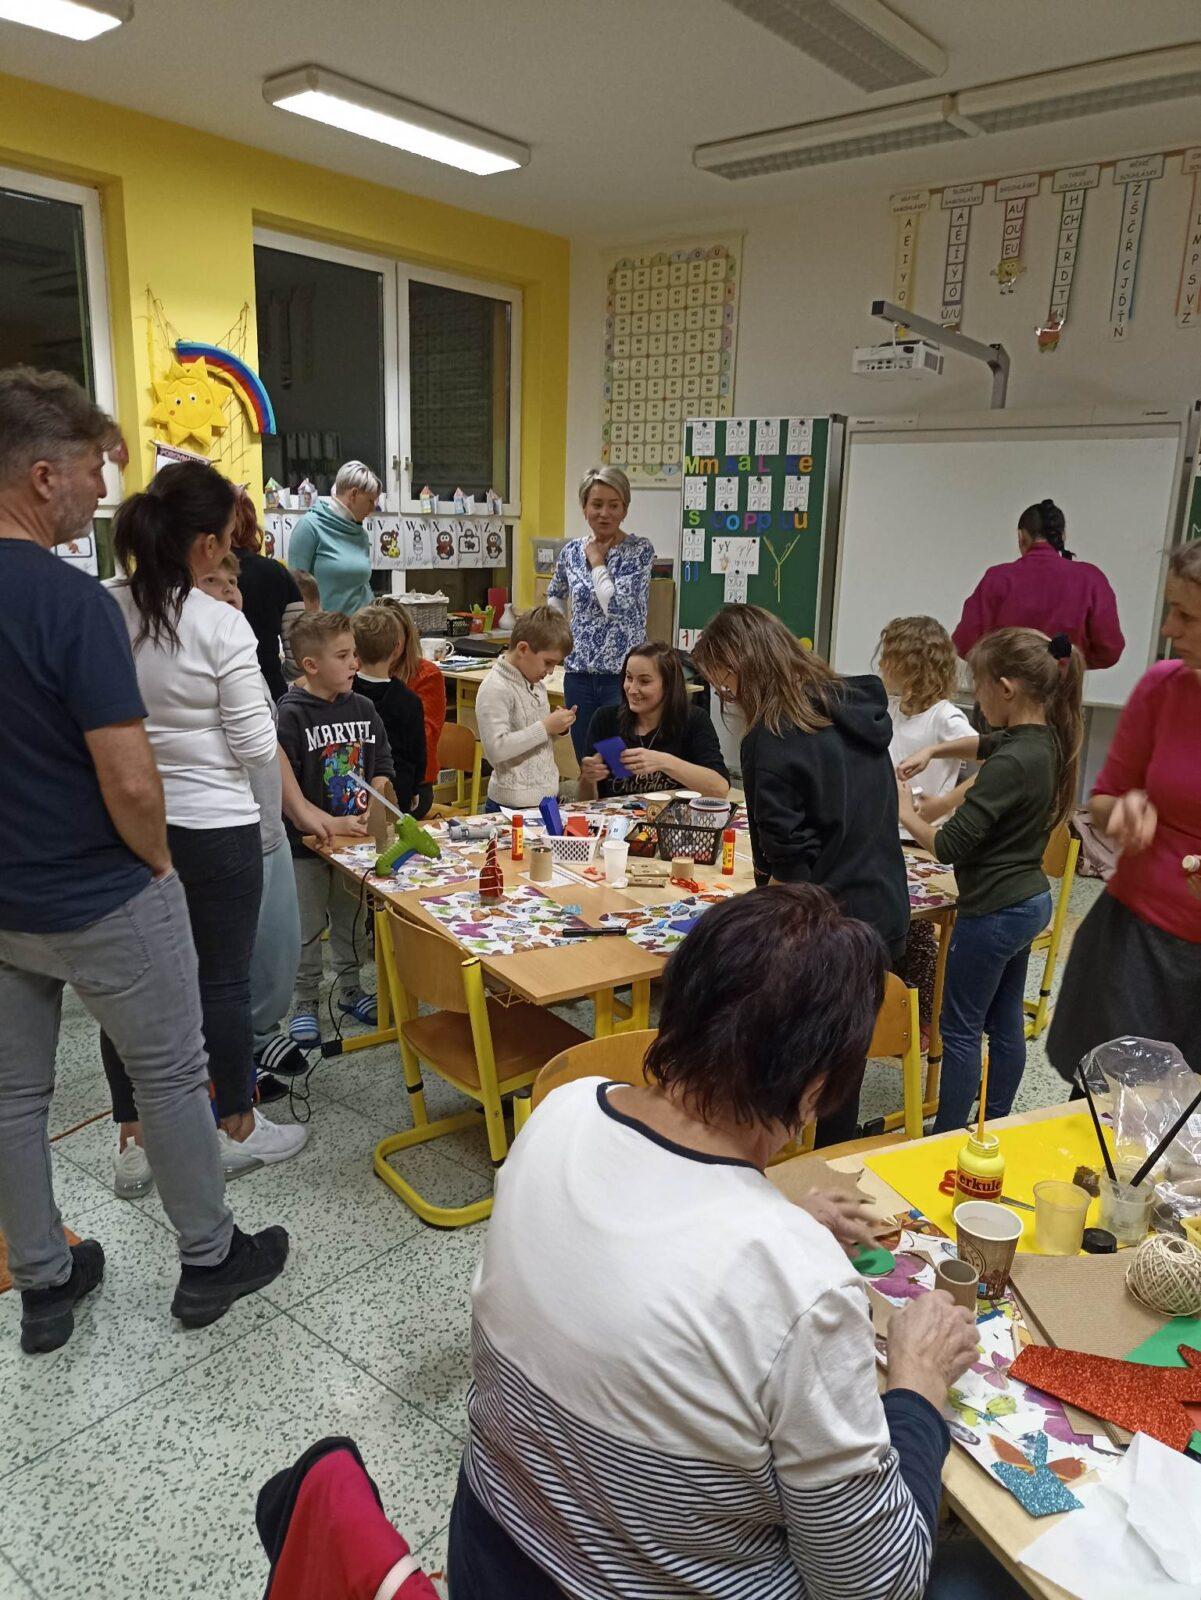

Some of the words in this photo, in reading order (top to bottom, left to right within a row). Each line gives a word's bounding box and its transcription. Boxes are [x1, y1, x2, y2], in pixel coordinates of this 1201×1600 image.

[1069, 194, 1079, 206] H
[1008, 204, 1024, 215] AU
[904, 219, 912, 228] A
[1063, 215, 1080, 226] CH
[1005, 225, 1020, 236] OU
[904, 235, 911, 246] E
[1066, 232, 1073, 243] K
[1004, 243, 1019, 255] EU
[1064, 252, 1071, 261] R
[901, 272, 907, 282] Y
[1061, 271, 1069, 281] D
[285, 518, 293, 530] S
[378, 520, 386, 530] V
[406, 521, 417, 531] W
[432, 521, 440, 533] X
[304, 720, 376, 752] MARVEL
